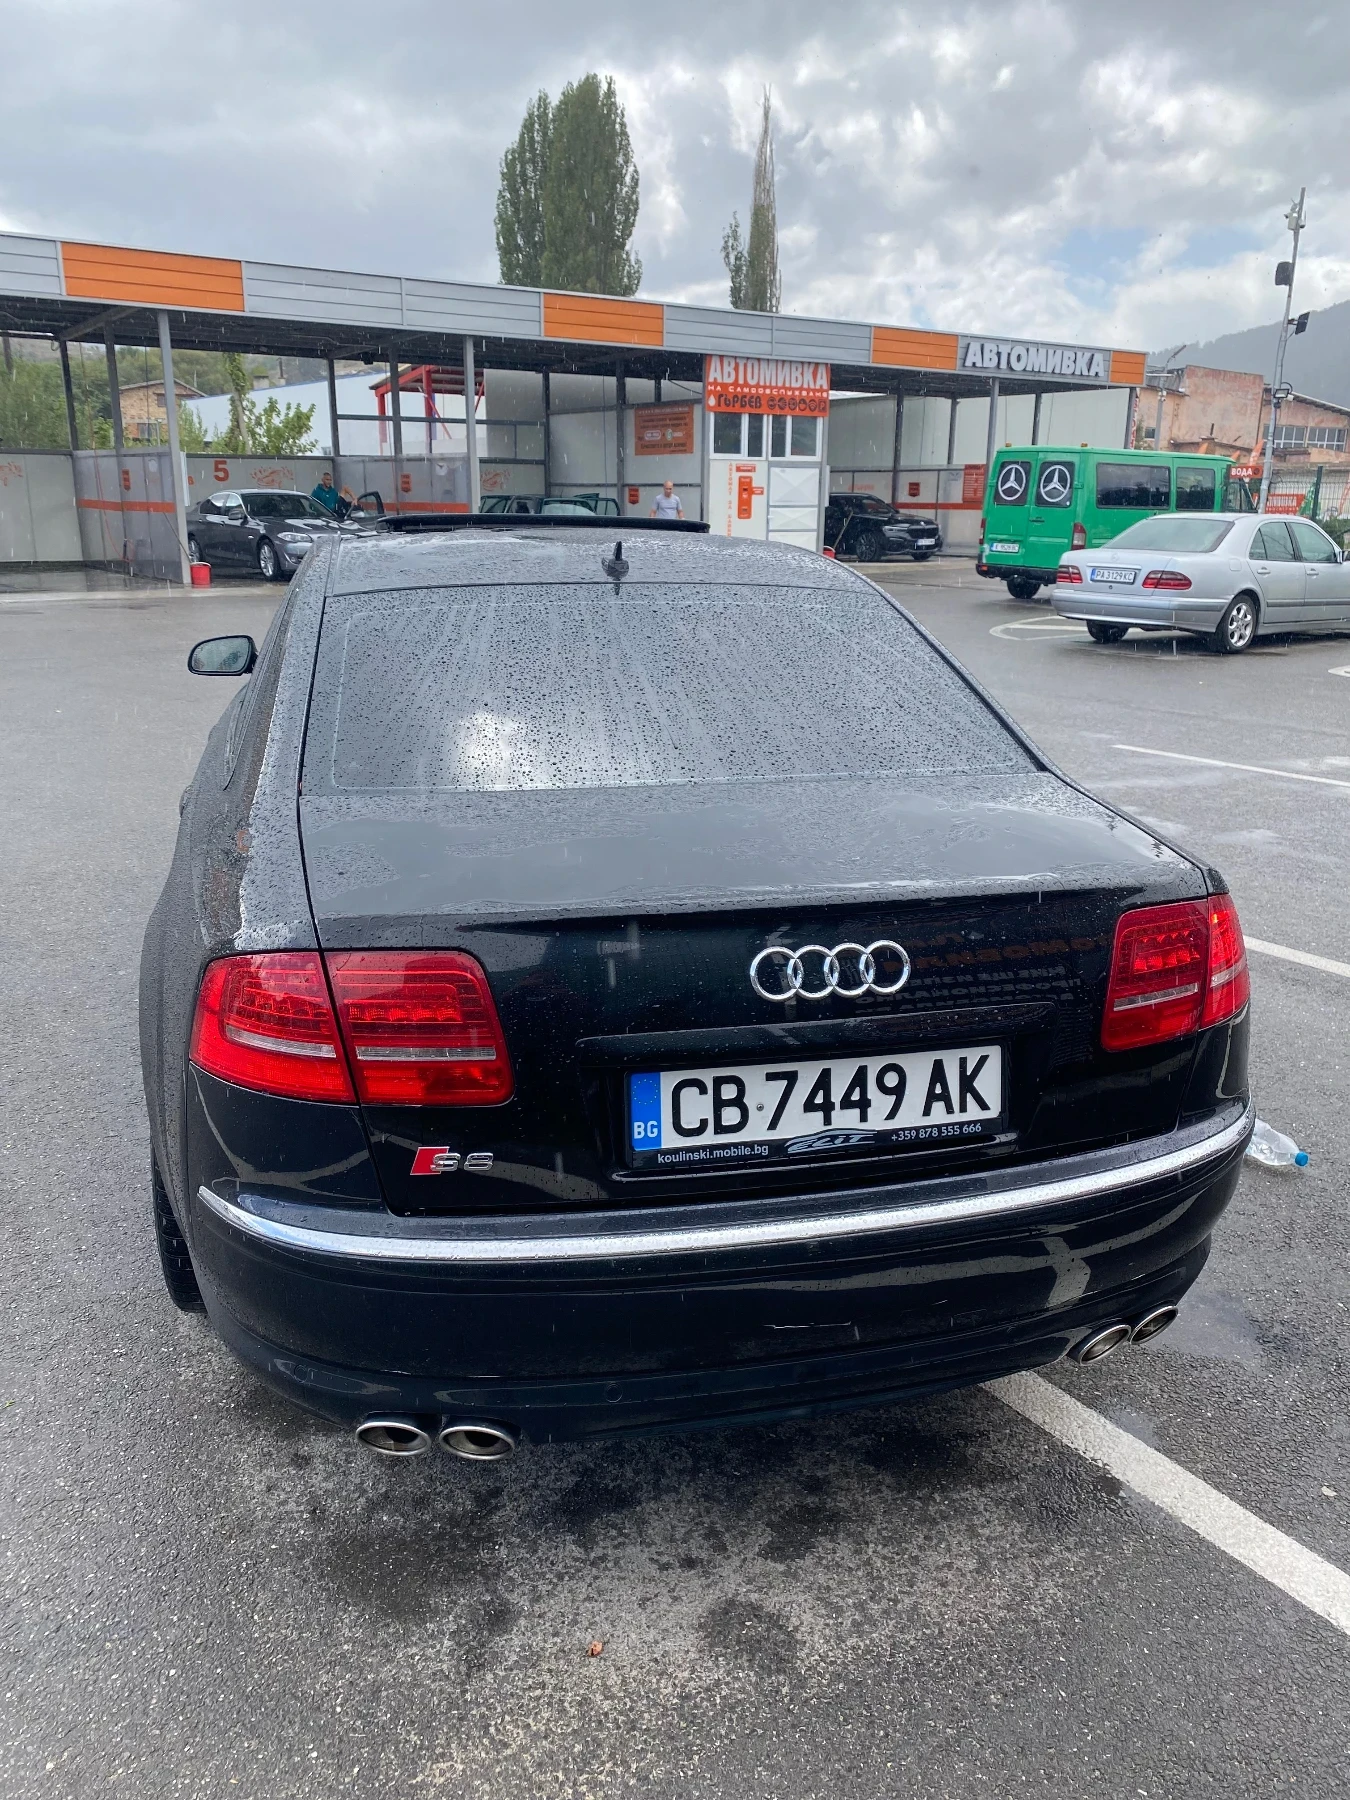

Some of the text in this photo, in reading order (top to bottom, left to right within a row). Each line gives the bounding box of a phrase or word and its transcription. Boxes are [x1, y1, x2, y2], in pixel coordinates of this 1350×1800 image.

[964, 341, 1105, 377] АВТОМИВКА
[708, 355, 828, 389] АВТОМИВКА
[213, 460, 230, 482] 5
[1231, 467, 1253, 477] ВОДА
[671, 1054, 991, 1138] CB 7449 AK
[633, 1121, 659, 1139] BG
[891, 1123, 982, 1142] +359 878 555 666
[430, 1152, 494, 1171] S8
[658, 1144, 769, 1164] koulinski.mobile.bg
